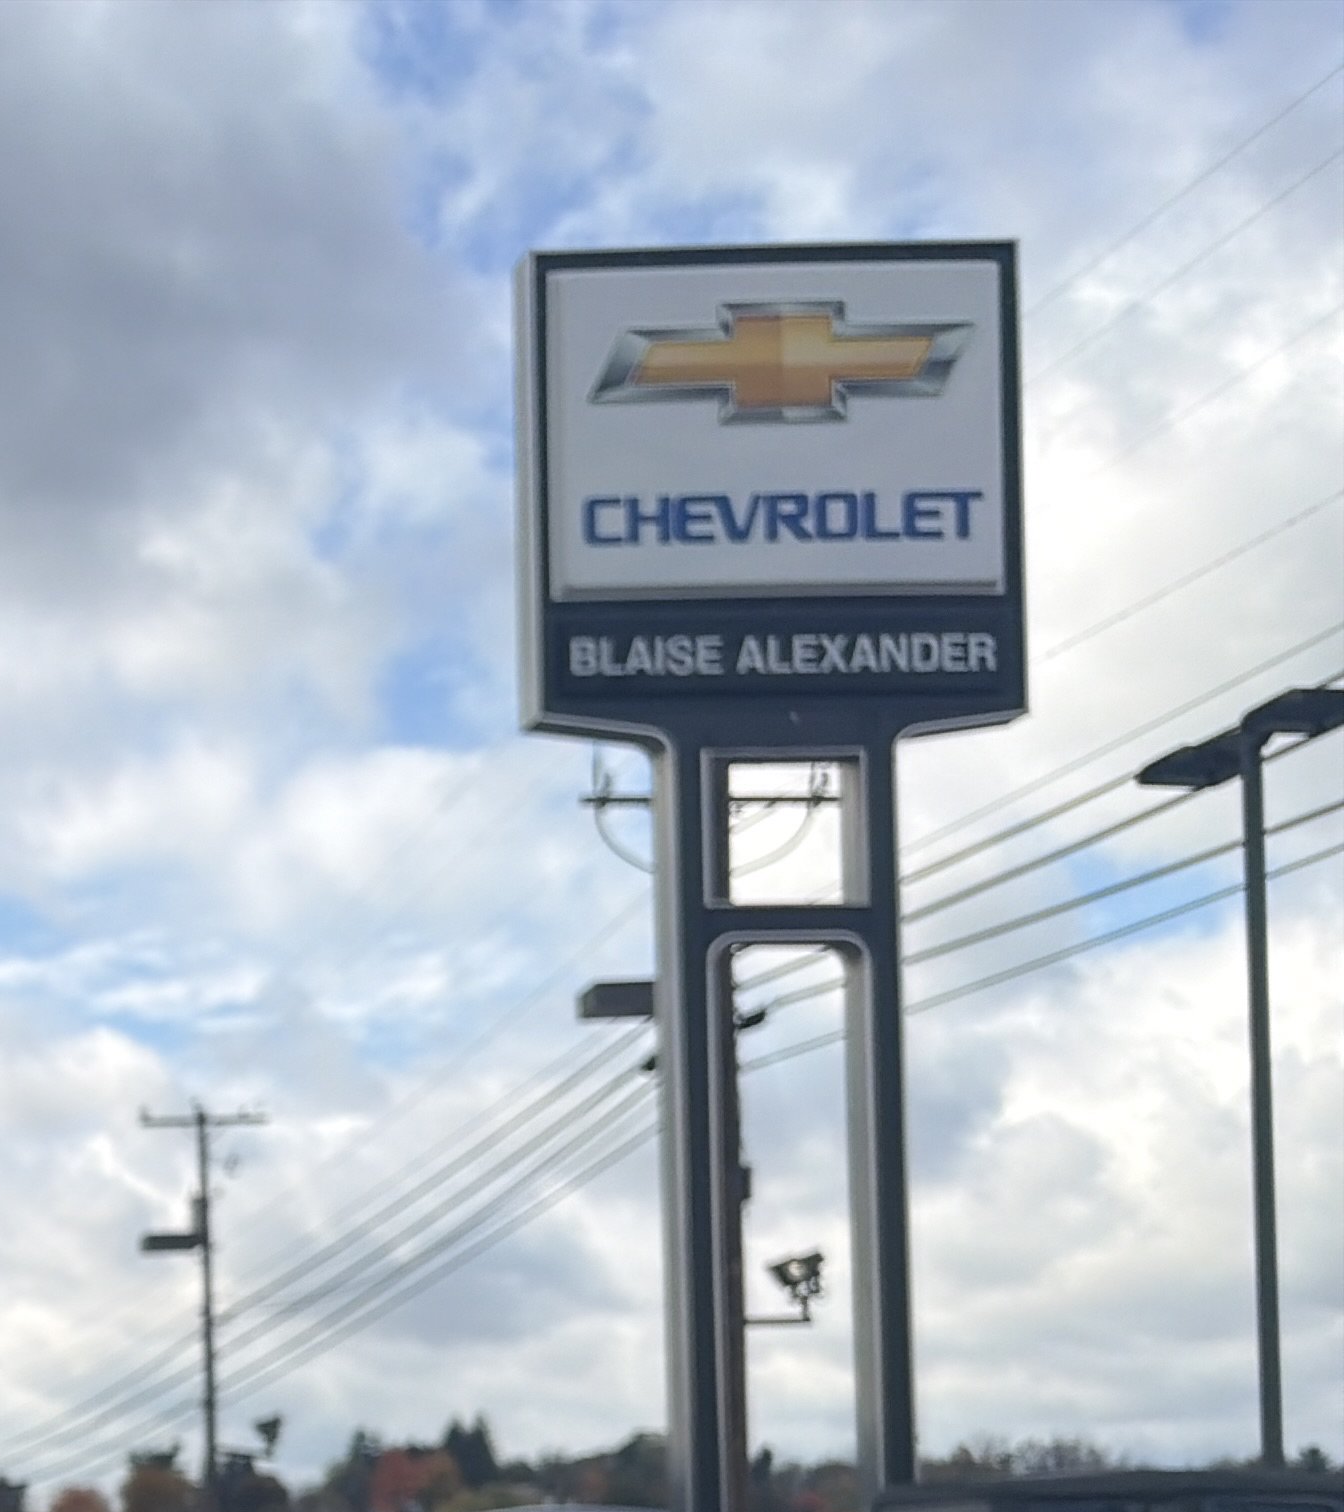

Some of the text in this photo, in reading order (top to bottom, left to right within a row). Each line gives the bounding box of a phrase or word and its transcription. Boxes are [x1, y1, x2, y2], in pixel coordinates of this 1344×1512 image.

[583, 490, 984, 546] CHEVROLET
[568, 632, 998, 677] BLAISE ALEXANDER
